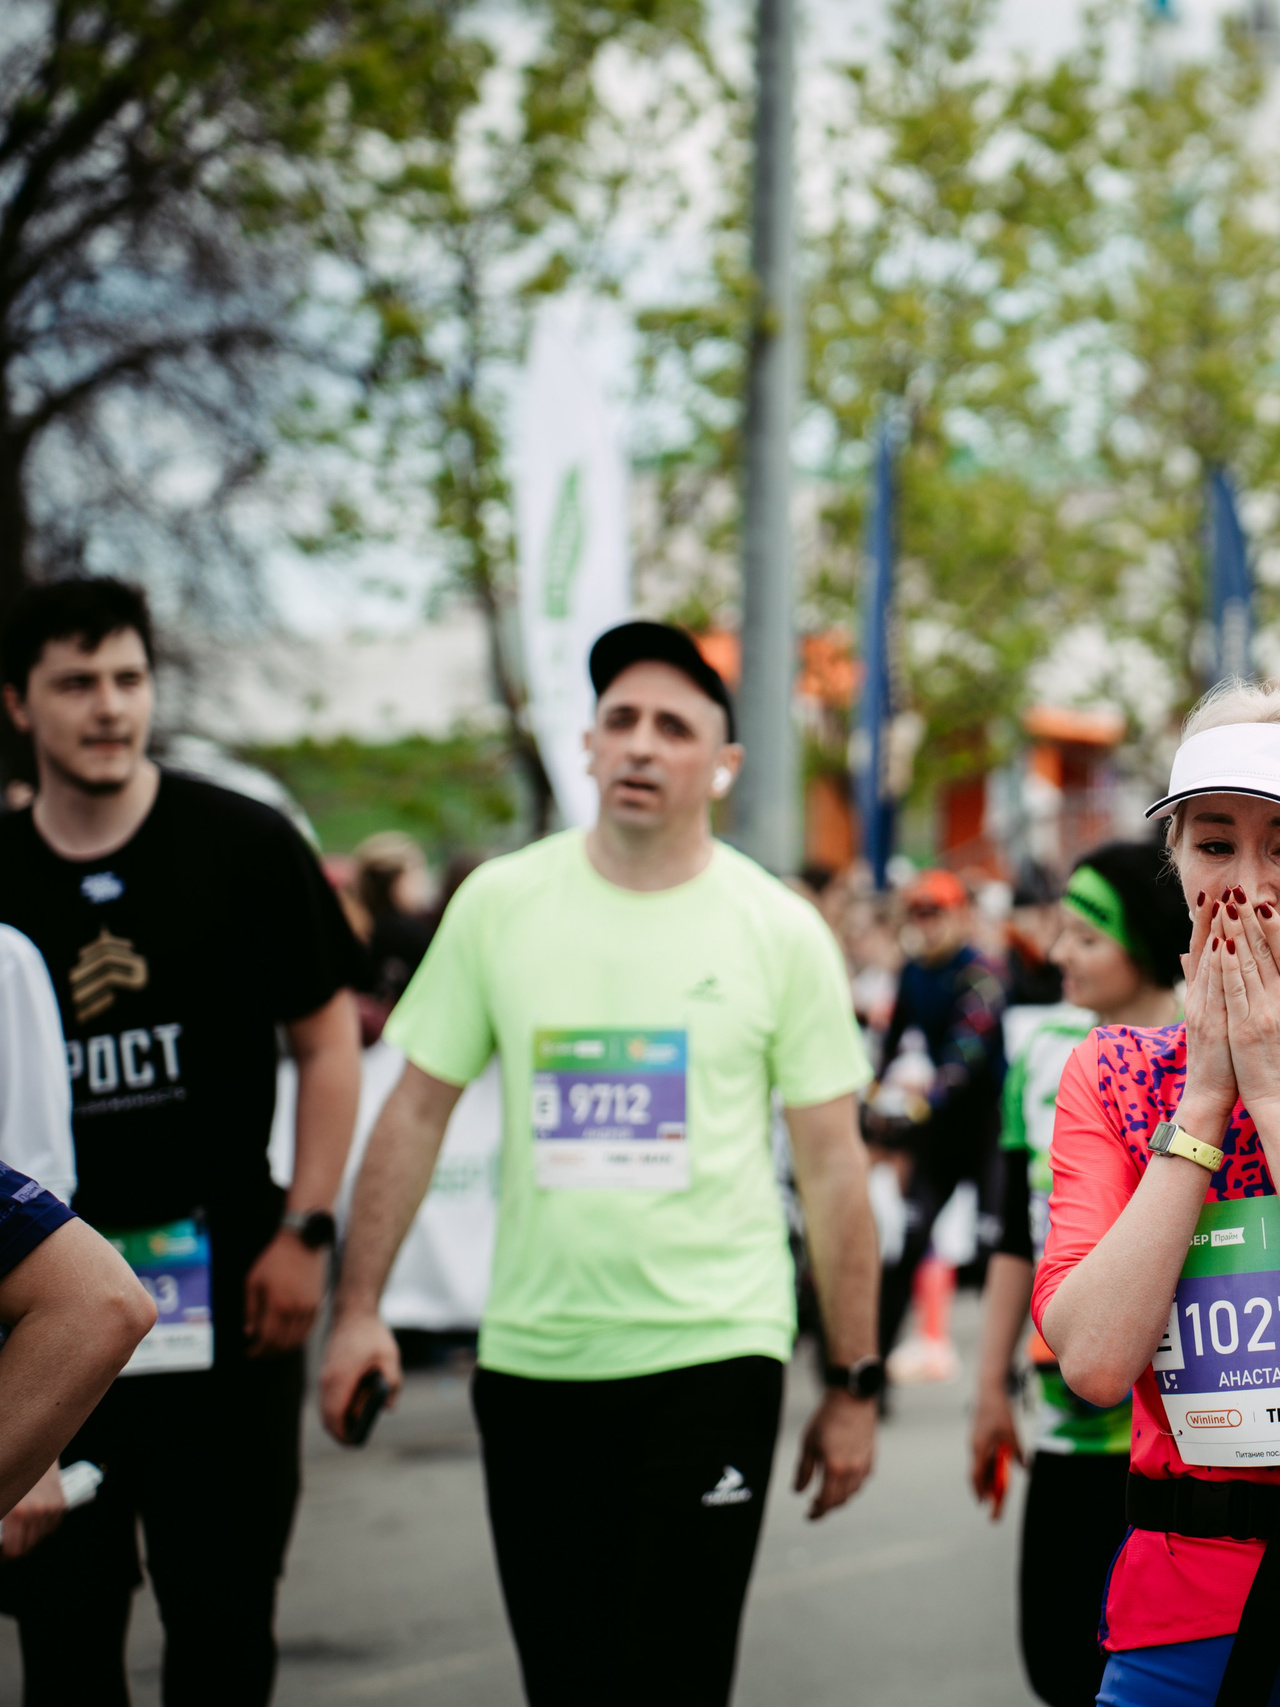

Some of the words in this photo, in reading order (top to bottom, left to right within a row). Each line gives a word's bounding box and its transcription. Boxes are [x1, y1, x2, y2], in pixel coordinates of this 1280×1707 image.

[568, 1083, 652, 1124] 9712
[1214, 1230, 1238, 1242] Прайм
[1189, 1413, 1226, 1425] Winline
[1235, 1450, 1265, 1458] Питание
